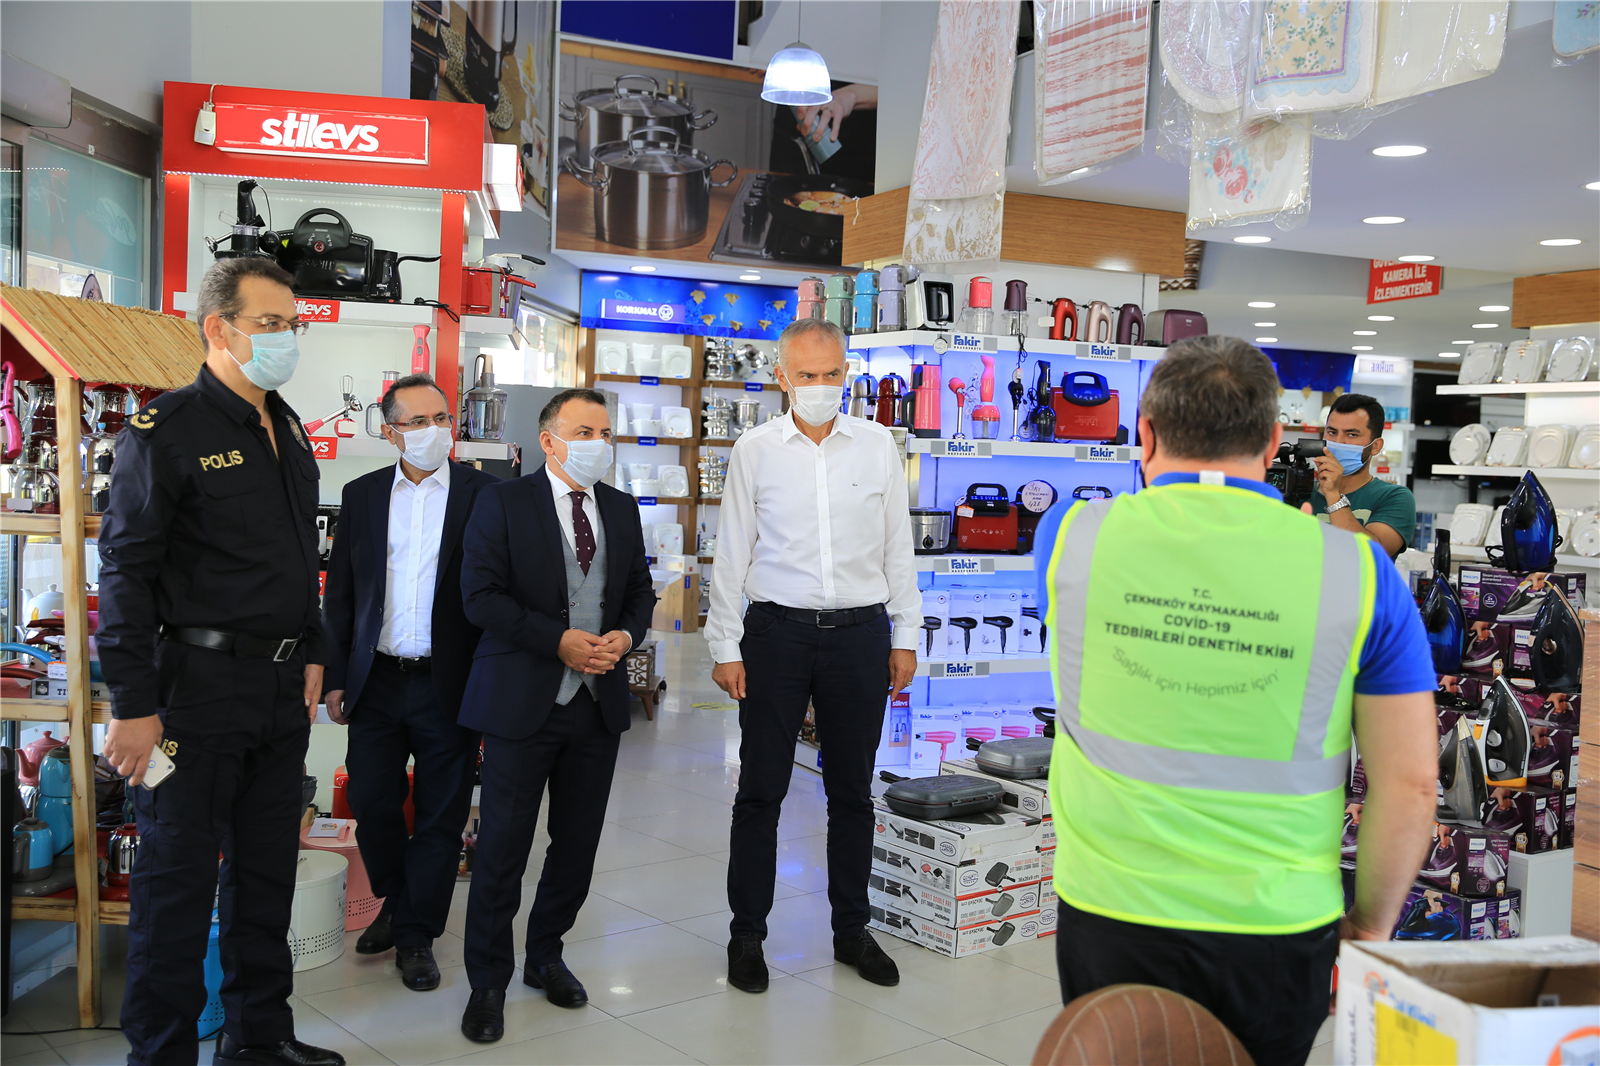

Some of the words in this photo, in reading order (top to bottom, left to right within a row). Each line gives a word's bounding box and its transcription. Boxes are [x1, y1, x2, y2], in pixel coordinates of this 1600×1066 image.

[260, 112, 380, 152] stilevs
[1382, 267, 1413, 283] KAMERA
[1414, 264, 1427, 279] İLE
[1374, 279, 1433, 301] İZLENMEKTEDİR
[616, 305, 658, 316] KORKMAZ
[954, 335, 981, 347] Fakir
[1091, 345, 1116, 356] Fakir
[948, 442, 975, 452] Fakir
[1090, 447, 1114, 457] Fakir
[951, 559, 978, 569] Fakir
[1192, 588, 1212, 599] T.C.
[1124, 593, 1187, 610] ÇEKMEKÖY
[1188, 602, 1280, 622] KAYMAKAMLIĞI
[1164, 614, 1232, 633] COVİD-19
[1104, 621, 1185, 645] TEDBİRLERİ
[1188, 635, 1252, 654] DENETİM
[1256, 644, 1295, 659] EKİBİ
[947, 663, 973, 673] Fakir
